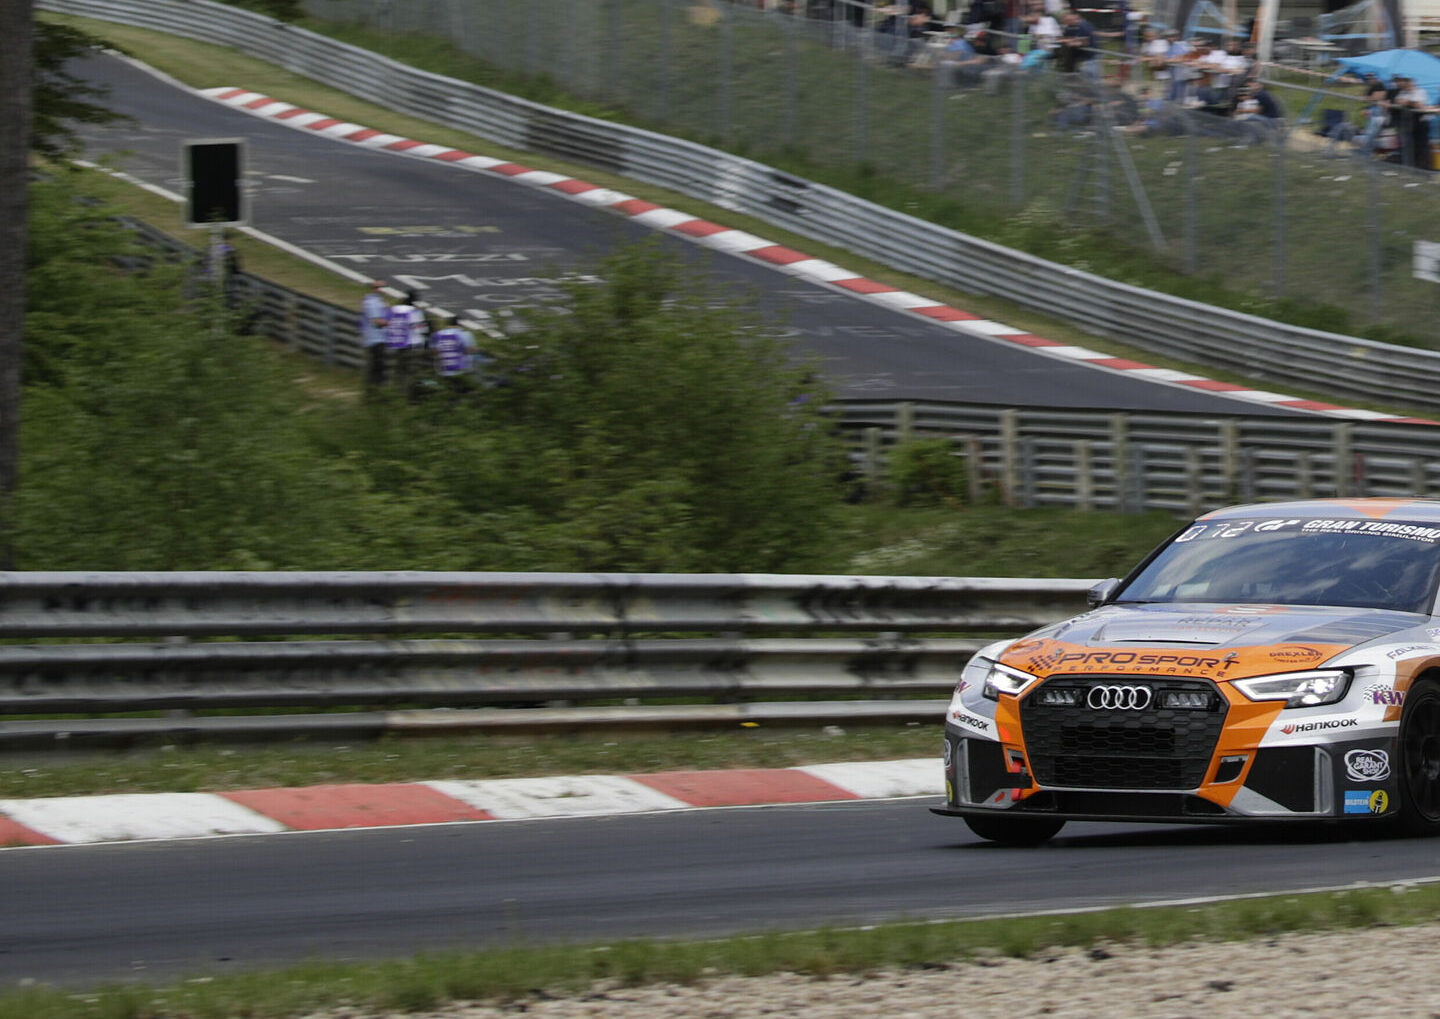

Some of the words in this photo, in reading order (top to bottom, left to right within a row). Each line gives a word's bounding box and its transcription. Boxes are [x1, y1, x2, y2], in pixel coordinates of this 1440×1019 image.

[1302, 519, 1355, 532] GRAN
[1344, 529, 1381, 537] DRIVING
[1382, 531, 1435, 543] SIMULATOR
[1373, 690, 1405, 706] KW
[1353, 761, 1384, 770] GARANT
